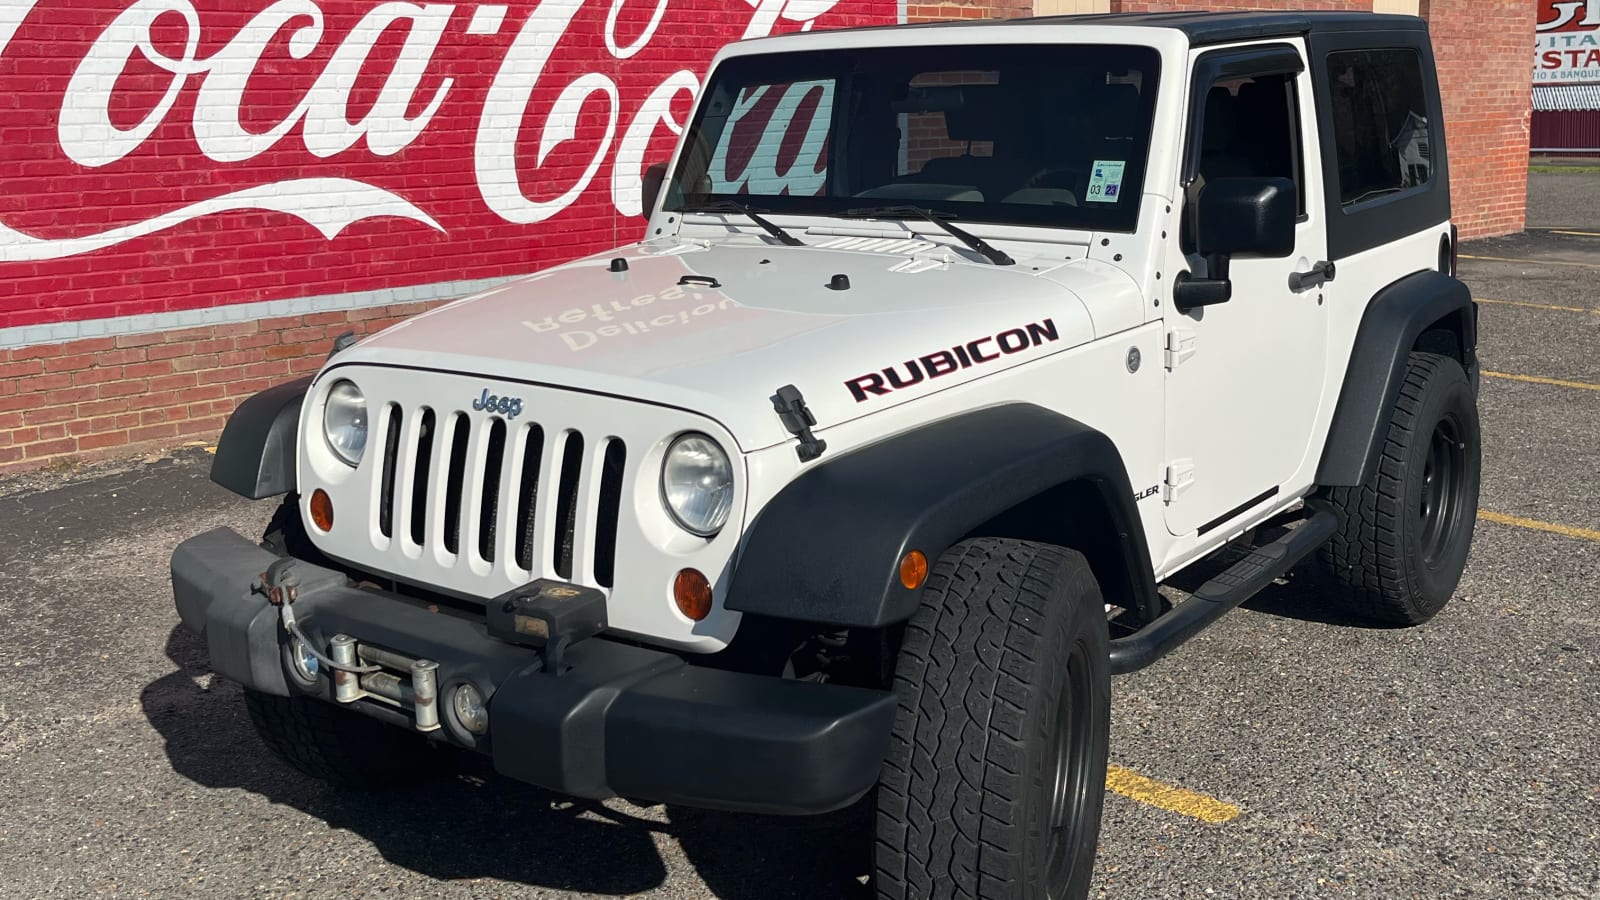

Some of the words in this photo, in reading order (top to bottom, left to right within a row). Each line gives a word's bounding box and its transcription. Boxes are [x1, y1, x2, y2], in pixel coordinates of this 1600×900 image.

[1534, 49, 1600, 69] STA
[1550, 71, 1557, 79] &
[0, 0, 838, 225] oca-Coa
[1091, 184, 1101, 195] 03
[1105, 185, 1117, 195] 23
[843, 318, 1059, 403] RUBICON
[472, 388, 522, 420] Jeep
